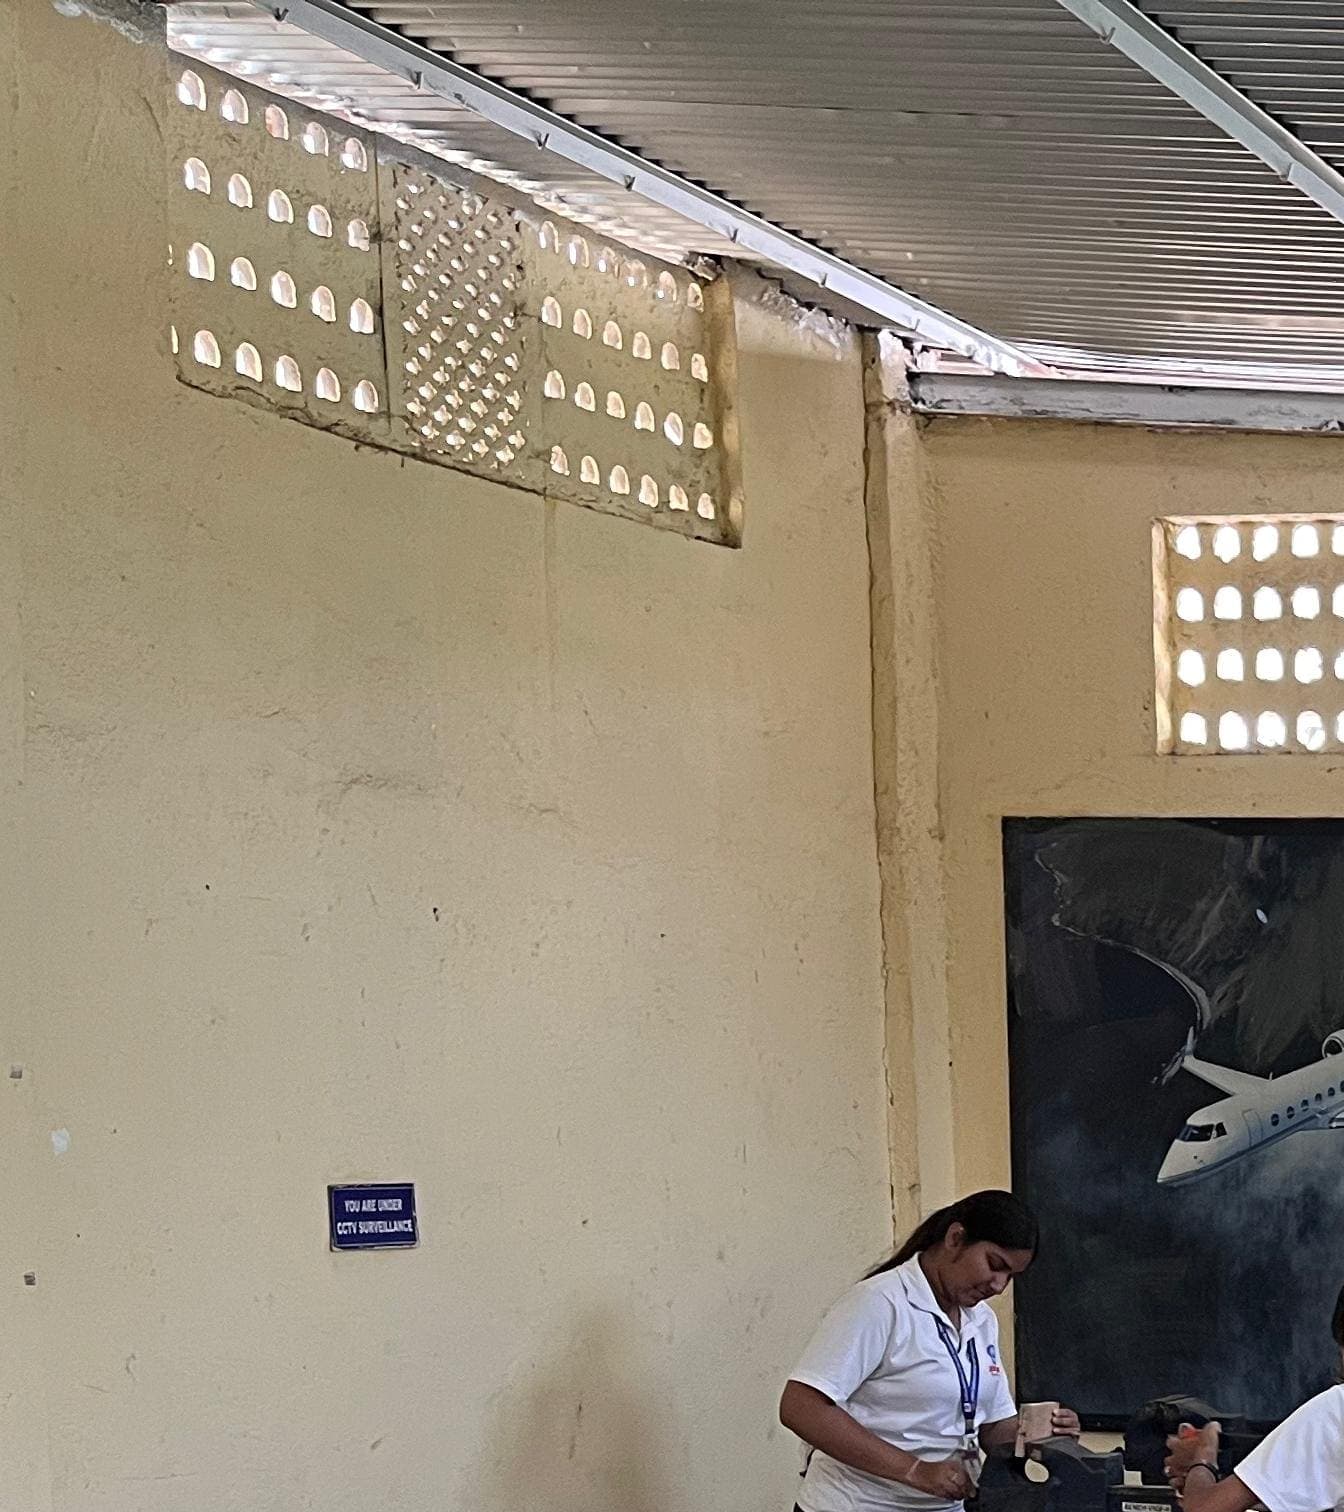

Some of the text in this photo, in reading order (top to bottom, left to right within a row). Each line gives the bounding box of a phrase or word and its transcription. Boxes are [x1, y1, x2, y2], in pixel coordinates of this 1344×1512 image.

[344, 1198, 403, 1213] YOU ARE UNDER
[337, 1219, 413, 1235] CCTV SURVEILLANCE
